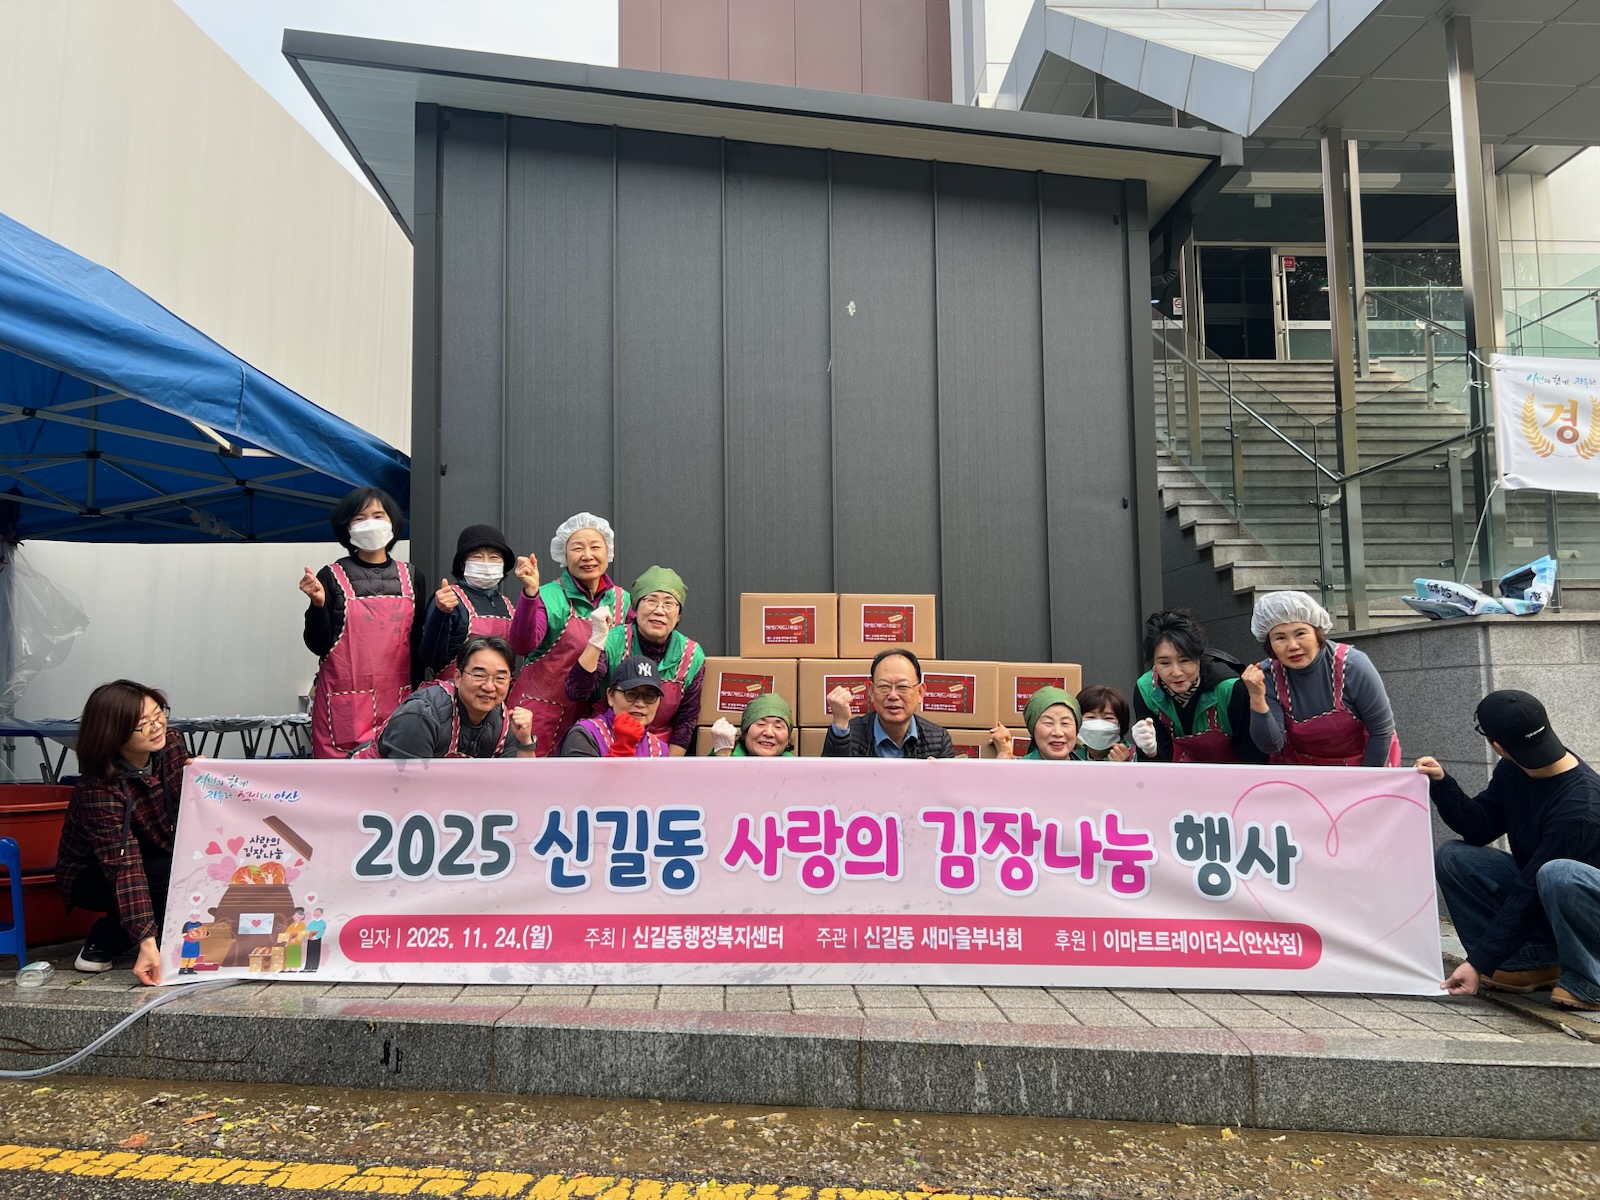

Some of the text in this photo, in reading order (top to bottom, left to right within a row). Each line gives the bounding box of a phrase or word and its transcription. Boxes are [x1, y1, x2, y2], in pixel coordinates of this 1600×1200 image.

[1543, 400, 1580, 444] 경
[638, 662, 652, 677] NY
[195, 773, 224, 790] 시민과
[237, 791, 271, 804] 혁신도시
[274, 790, 301, 802] 안산
[243, 846, 284, 860] 김장나눔
[249, 835, 280, 848] 사랑의
[355, 809, 1298, 897] 2025 신길동 사랑의 김장나눔 행사
[359, 925, 553, 951] 일자 2025. 11. 24.(월)
[584, 926, 784, 950] 주최 신길동행정복지센터
[816, 926, 1022, 951] 주관 신길동 새마을부녀회
[1054, 928, 1303, 957] 후원 이마트트레이더스(안산점)
